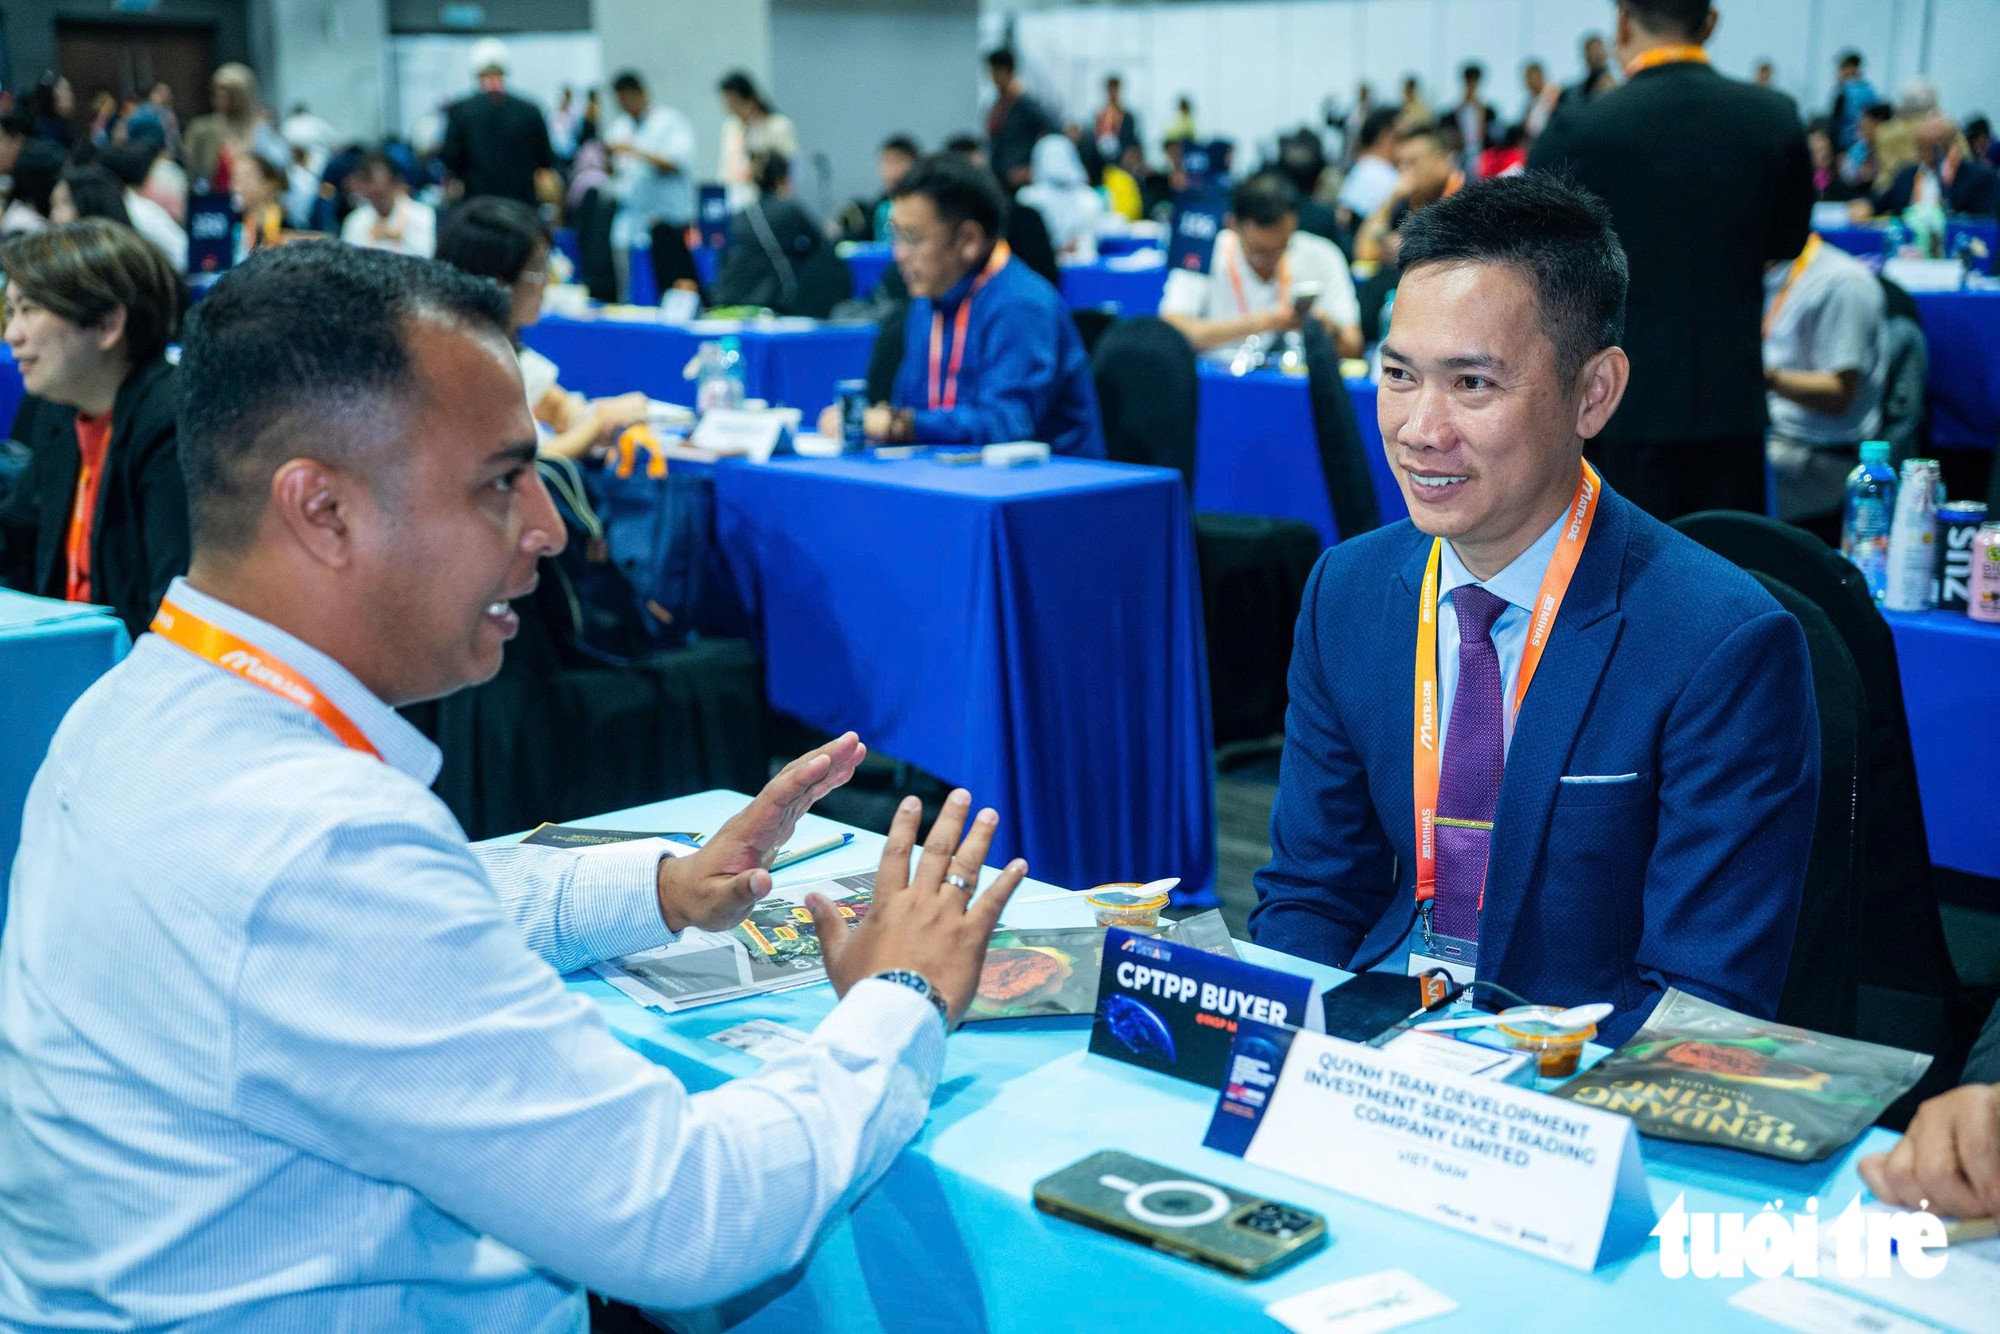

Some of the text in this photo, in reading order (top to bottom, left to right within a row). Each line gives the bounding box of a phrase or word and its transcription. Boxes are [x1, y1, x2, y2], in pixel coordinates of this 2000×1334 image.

[1566, 477, 1594, 541] MATRADE
[1942, 525, 1976, 601] ZUS
[1531, 609, 1551, 648] MIHAS
[1420, 680, 1433, 751] MATRADE
[1421, 808, 1432, 846] MIHAS
[1116, 960, 1198, 1004] CPTPP
[1200, 982, 1288, 1028] BUYER
[1304, 1068, 1417, 1112] INVESTMENT
[1422, 1101, 1500, 1137] SERVICE
[1508, 1124, 1596, 1168] TRADING
[1319, 1051, 1590, 1139] QUYNH TRAN DEVELOPMENT
[1573, 1084, 1808, 1154] RENDANG
[1354, 1102, 1530, 1167] COMPANY LIMITED
